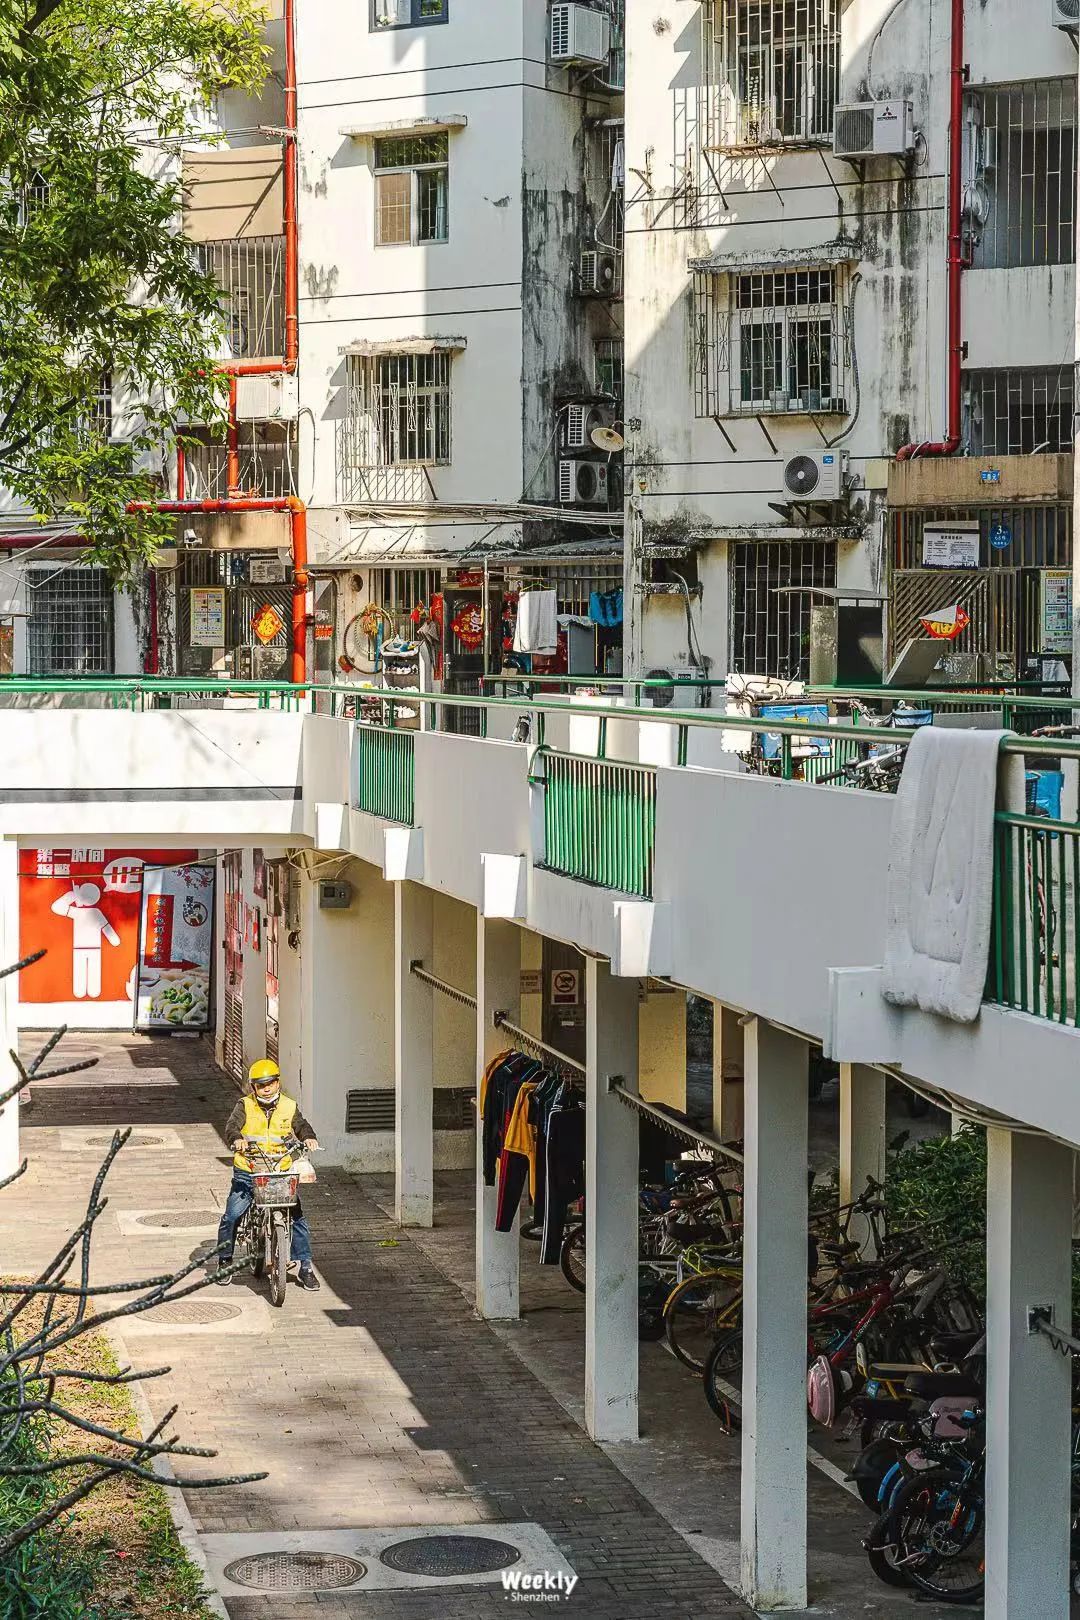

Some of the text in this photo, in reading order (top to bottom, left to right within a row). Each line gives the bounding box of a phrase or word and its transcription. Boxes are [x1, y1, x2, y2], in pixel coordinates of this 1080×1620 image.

[37, 848, 105, 862] 第一时间
[37, 863, 70, 878] 报警
[112, 866, 142, 883] 119
